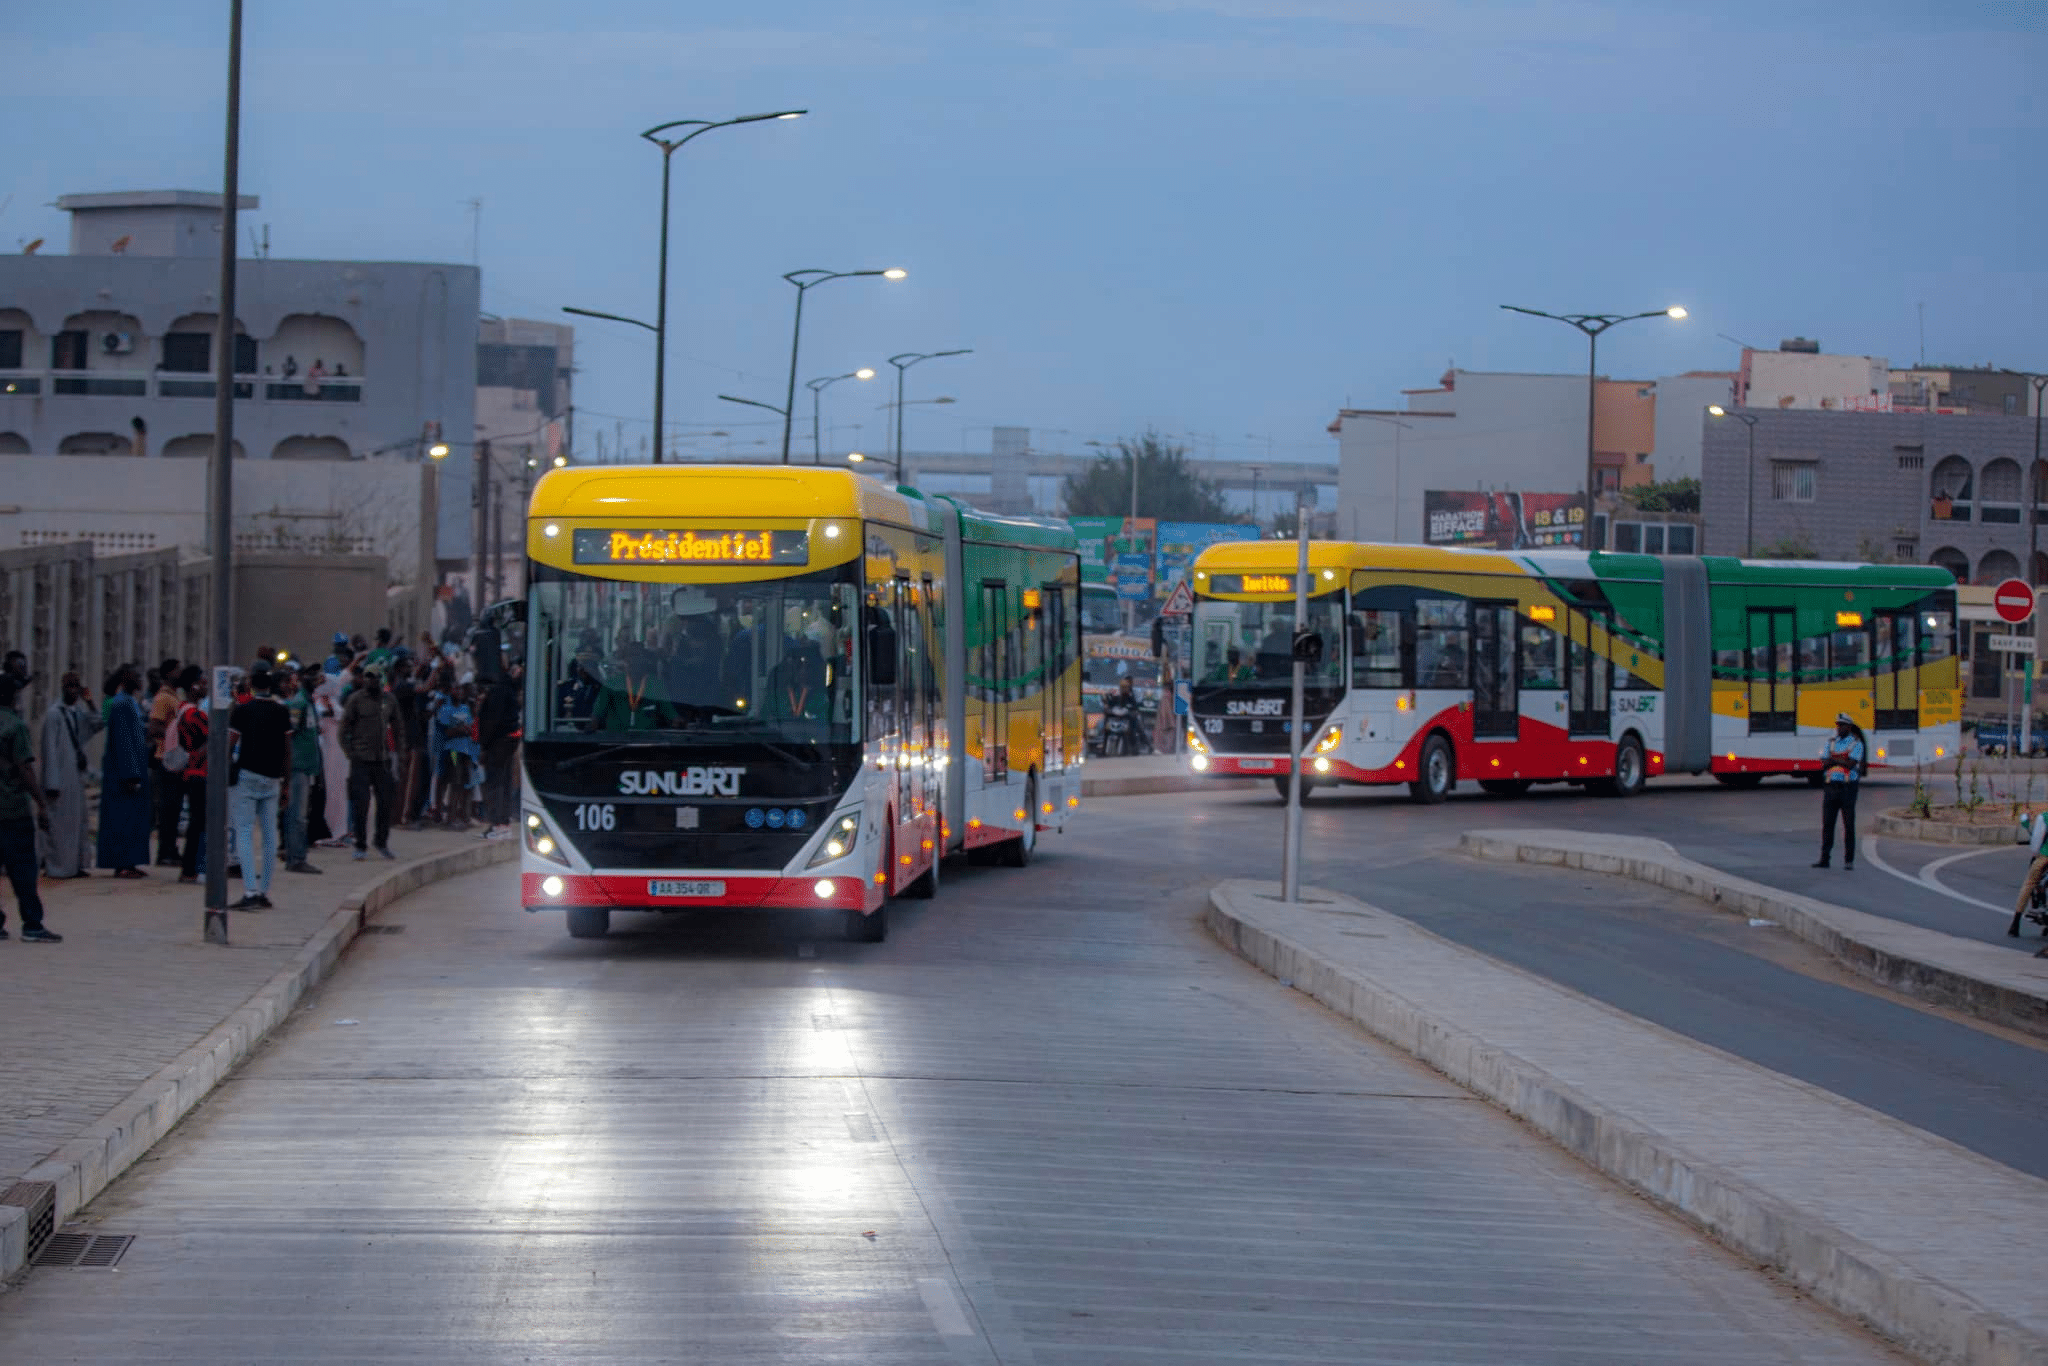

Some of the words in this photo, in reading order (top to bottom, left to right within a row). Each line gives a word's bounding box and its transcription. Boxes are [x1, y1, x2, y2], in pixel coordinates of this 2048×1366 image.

[1431, 511, 1484, 521] MARATHON
[1431, 519, 1484, 534] EIFFAGE
[611, 532, 772, 559] Présidentiel
[1204, 719, 1223, 733] 120
[574, 804, 616, 831] 106
